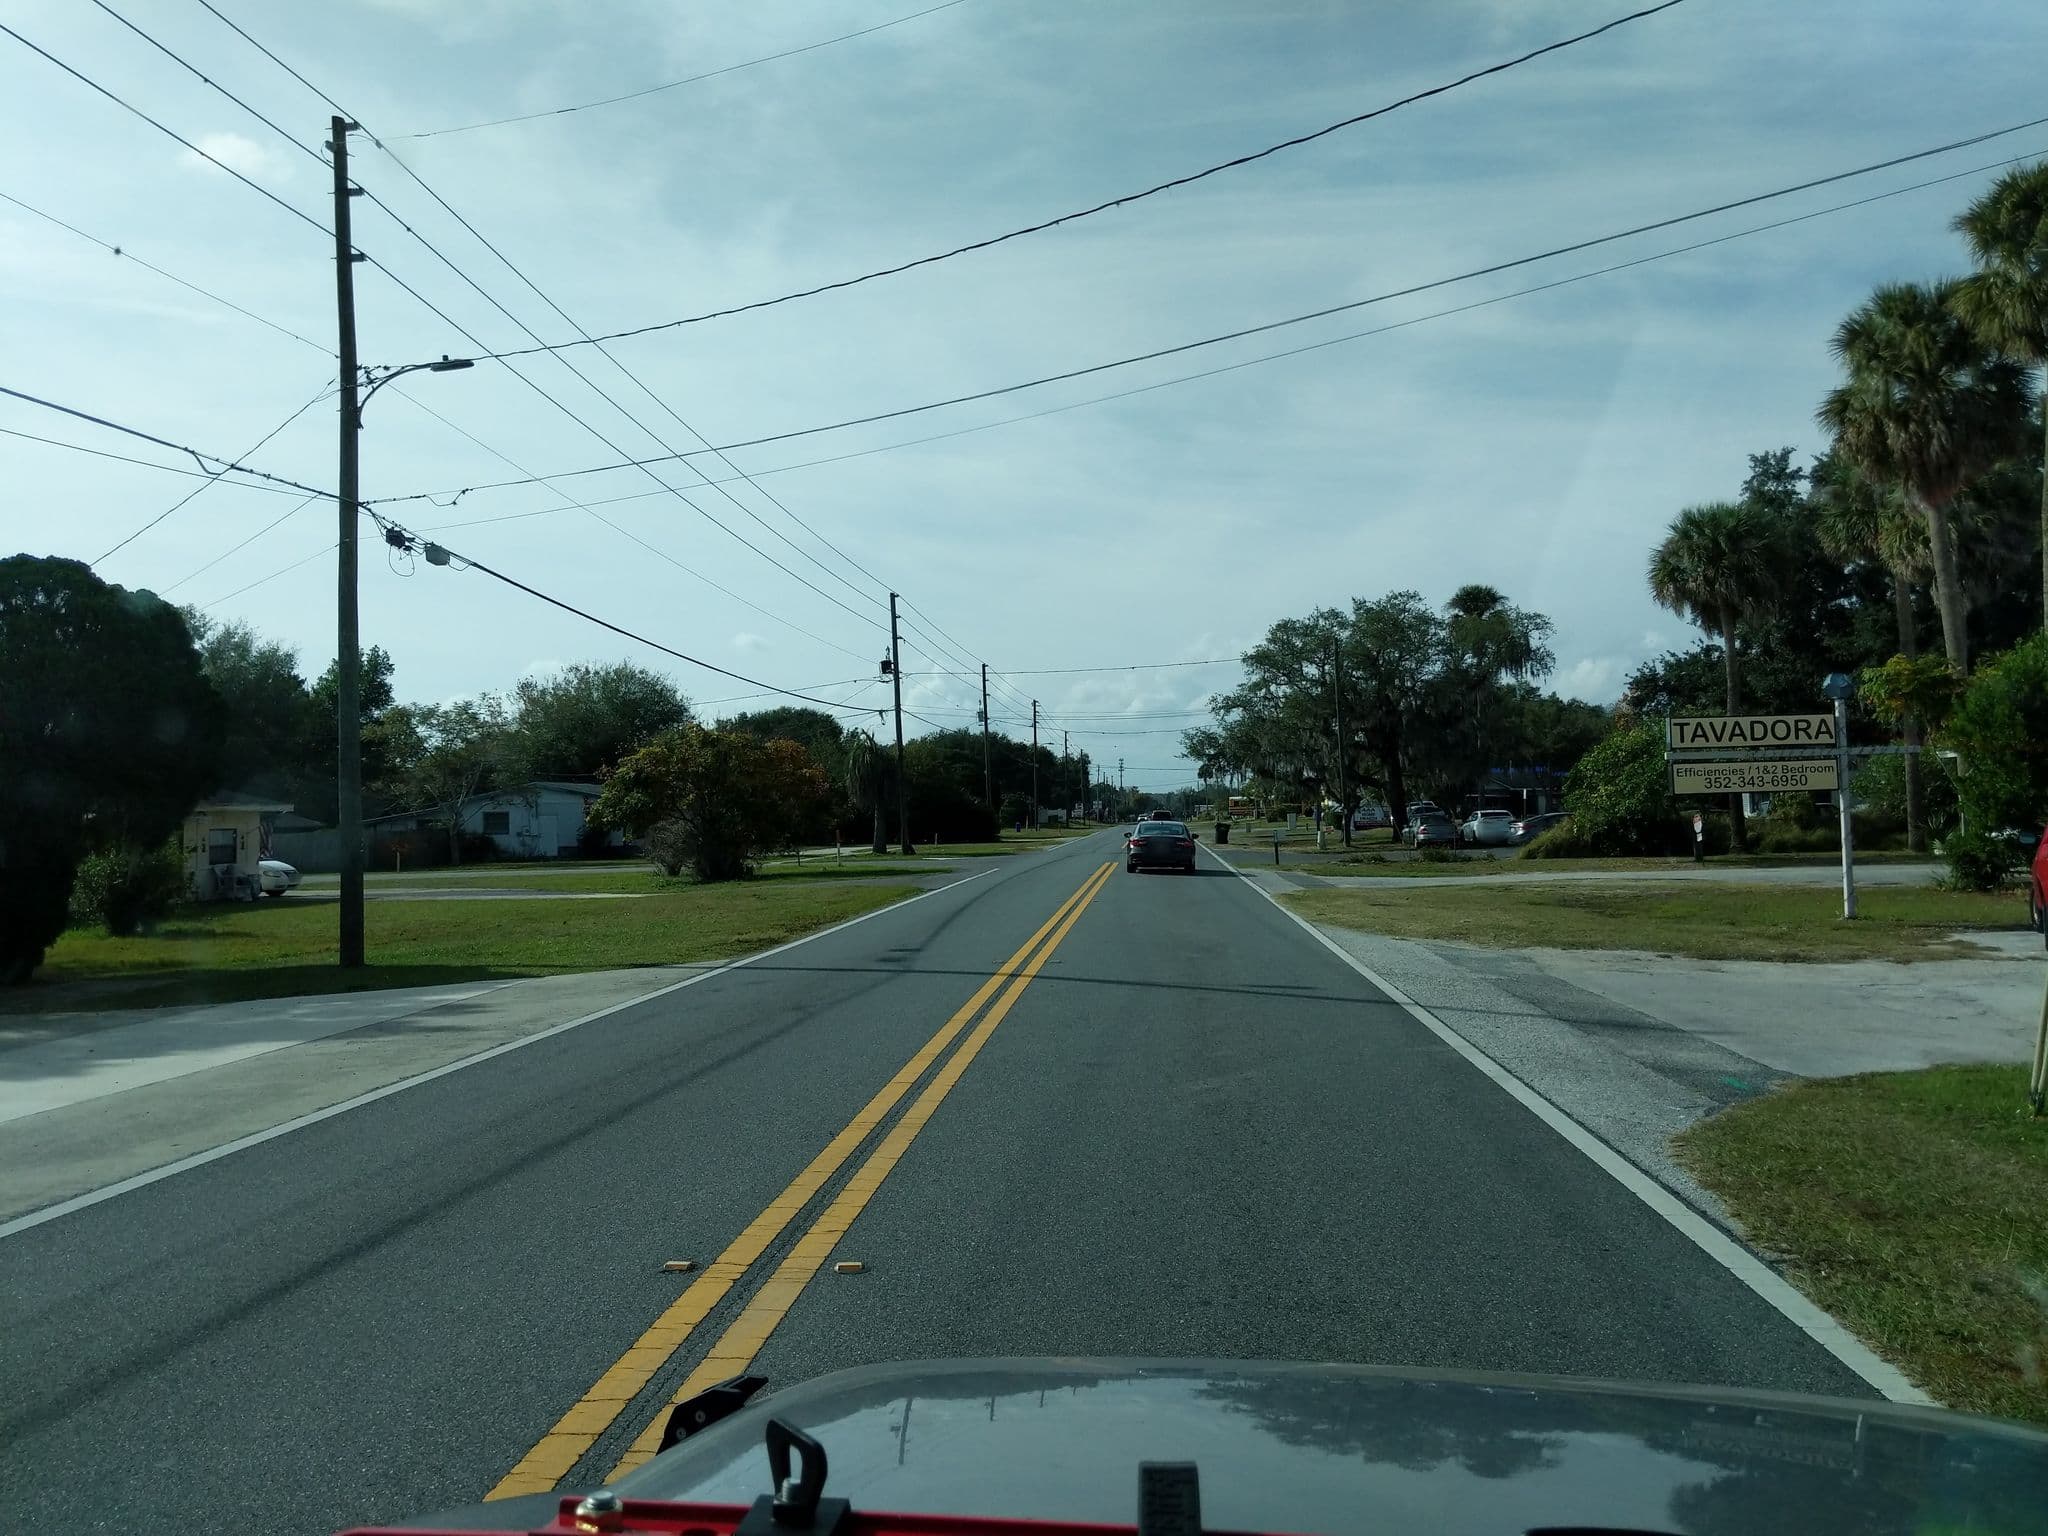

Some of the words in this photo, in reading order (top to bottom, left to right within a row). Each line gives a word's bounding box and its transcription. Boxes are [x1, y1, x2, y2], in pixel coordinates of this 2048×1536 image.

[1672, 718, 1835, 744] TAVADORA
[1676, 765, 1745, 778] Efficiencies
[1755, 765, 1778, 775] 1&2
[1781, 763, 1834, 774] Bedroom
[1704, 774, 1808, 789] 352-343-6950
